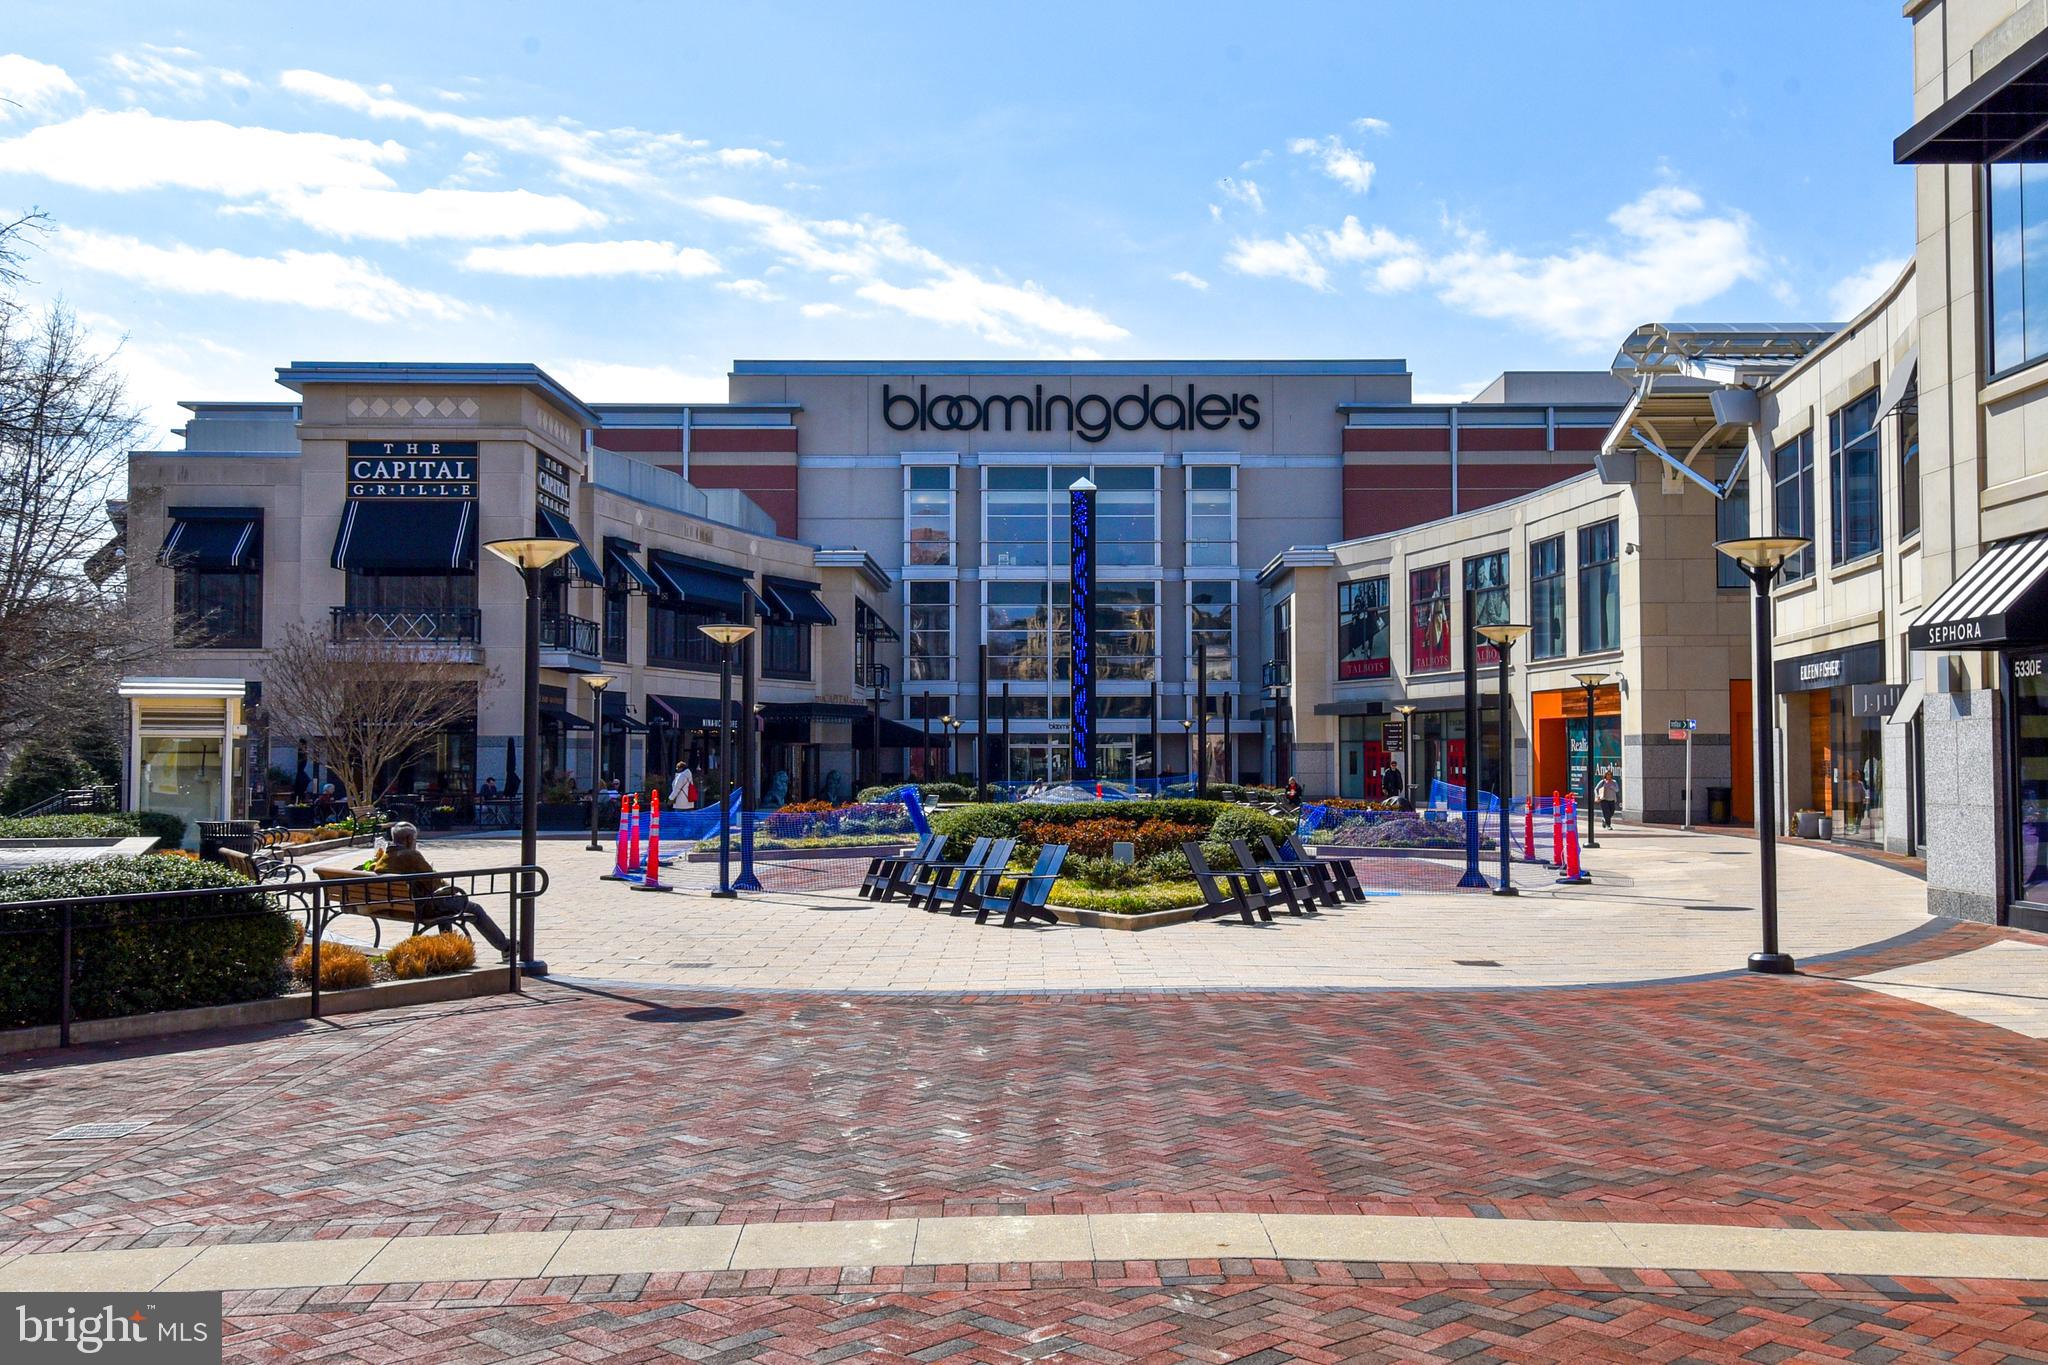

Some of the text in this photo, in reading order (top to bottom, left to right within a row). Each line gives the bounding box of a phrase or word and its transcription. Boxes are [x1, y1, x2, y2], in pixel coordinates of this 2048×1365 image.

[883, 384, 1261, 443] bloomingdale's
[383, 443, 441, 455] THE
[353, 461, 470, 479] CAPITAL
[538, 470, 569, 502] CAPITAL
[1929, 622, 1982, 644] SEPHORA
[1347, 662, 1385, 674] TALBOTS
[1416, 655, 1449, 669] TALBOTS
[1800, 659, 1840, 680] EILEEN FISHER
[2014, 660, 2043, 678] 5330E
